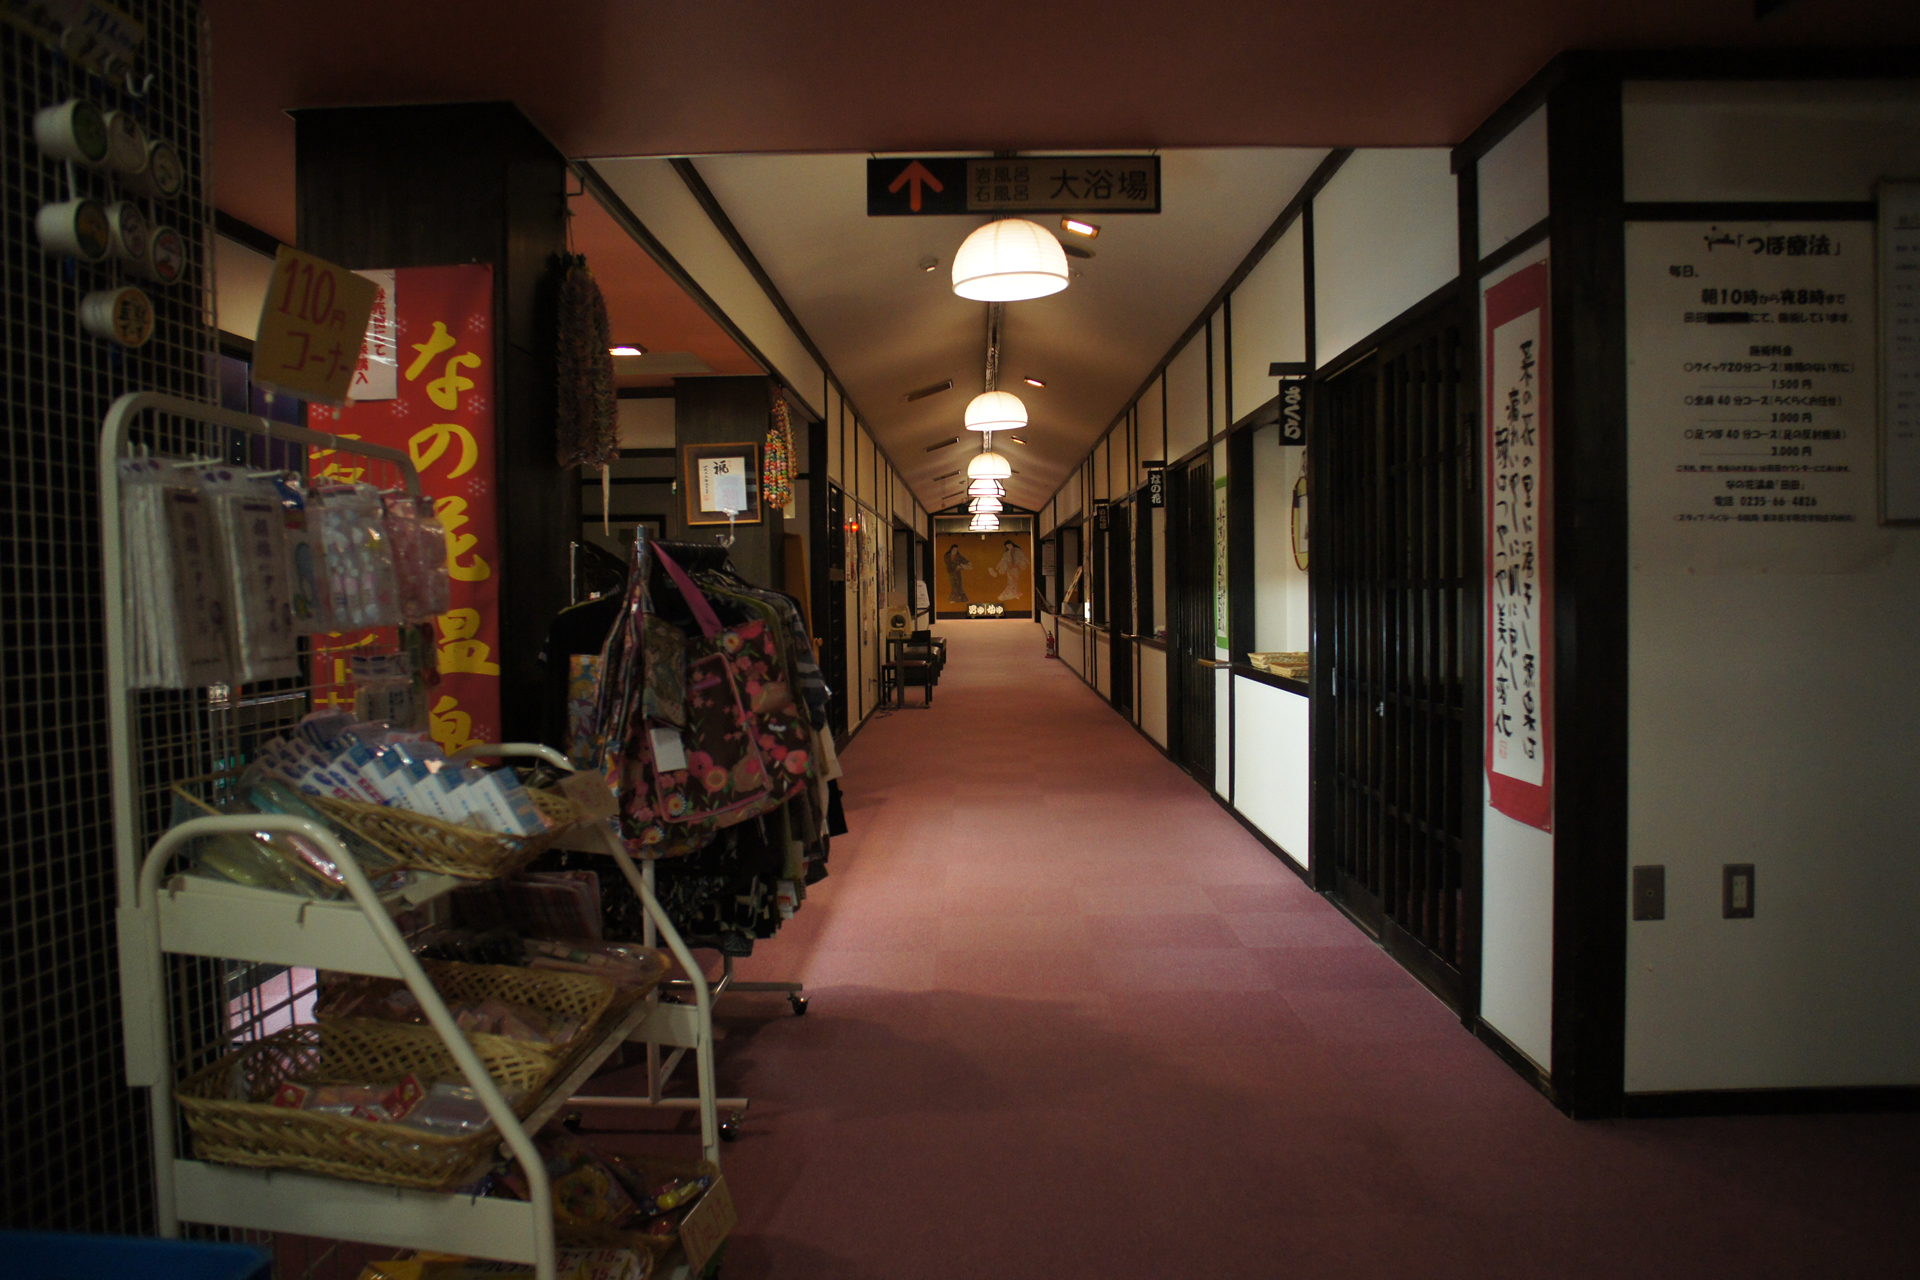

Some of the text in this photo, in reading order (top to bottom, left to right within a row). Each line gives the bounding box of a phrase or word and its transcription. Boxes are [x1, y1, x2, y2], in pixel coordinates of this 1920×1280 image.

[975, 167, 1030, 183] 岩風呂
[1049, 168, 1148, 201] 大浴場
[975, 185, 1030, 202] 石風呂
[277, 257, 347, 332] 110円
[281, 330, 350, 382] コーナー
[1149, 473, 1163, 505] なの花
[1714, 495, 1734, 507] 電話
